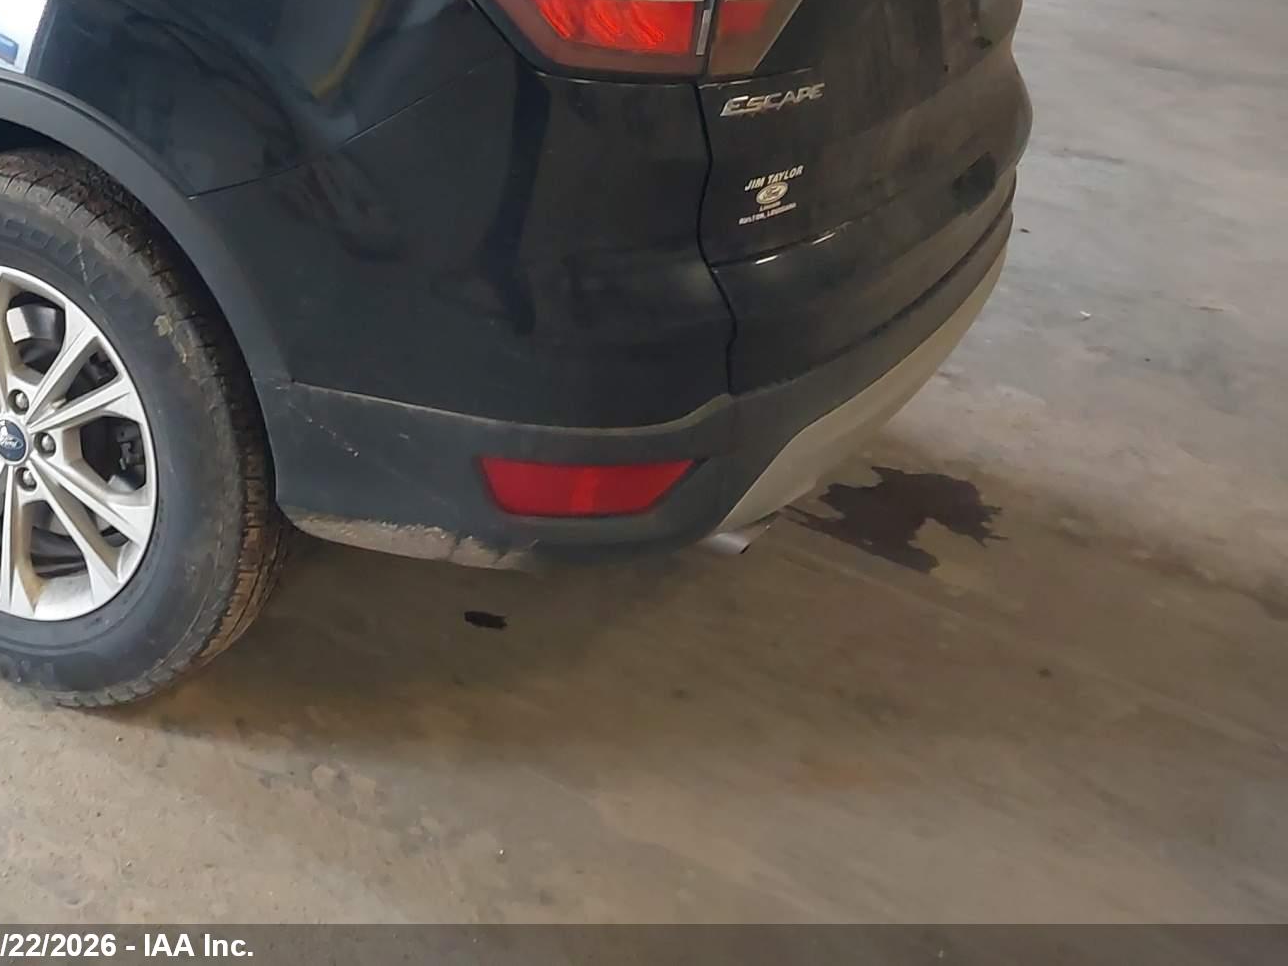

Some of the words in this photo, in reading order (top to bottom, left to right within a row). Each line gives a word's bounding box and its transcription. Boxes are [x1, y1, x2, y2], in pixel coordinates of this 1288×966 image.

[720, 83, 825, 116] ESCAPE
[744, 177, 766, 191] JIM
[767, 165, 804, 185] TAYLOR
